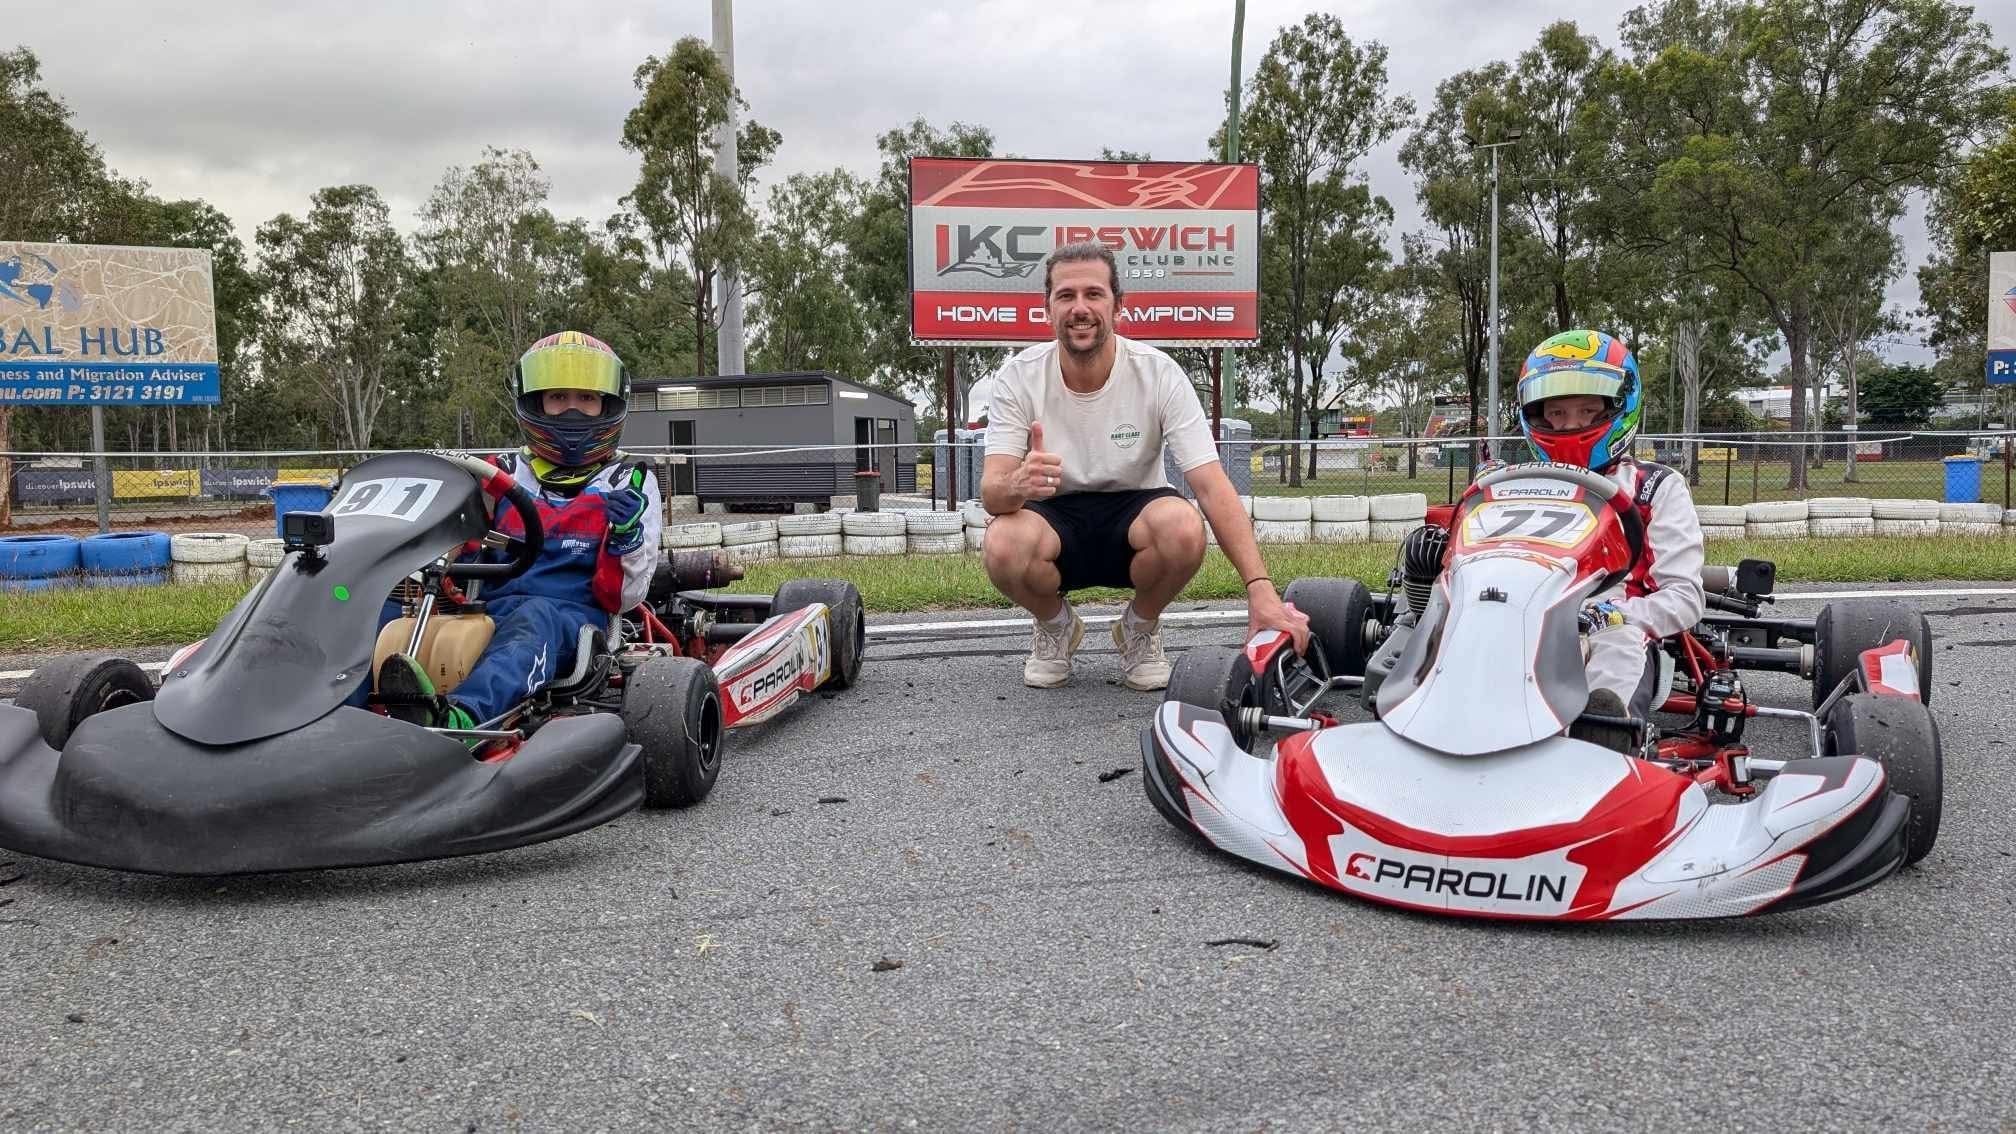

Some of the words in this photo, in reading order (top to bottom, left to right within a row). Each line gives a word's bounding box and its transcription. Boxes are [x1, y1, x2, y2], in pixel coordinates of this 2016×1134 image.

[1056, 224, 1235, 251] IPSWICH
[1127, 255, 1185, 266] CLUB
[1198, 255, 1235, 266] INC
[1125, 269, 1166, 279] 1958
[937, 306, 1017, 322] HOME
[1028, 307, 1048, 323] O
[1120, 306, 1235, 322] AMPIONS
[80, 326, 167, 356] HUB
[36, 369, 64, 381] and
[70, 367, 144, 384] Migration
[150, 369, 206, 381] Adviser
[1993, 360, 2009, 375] P:
[0, 385, 62, 400] u.com
[68, 385, 85, 400] P:
[90, 385, 135, 400] 3121
[141, 385, 185, 400] 3191
[337, 483, 428, 516] 91
[1508, 488, 1570, 497] PAROLIN
[1485, 509, 1577, 538] 77
[753, 648, 805, 700] PAROLIN
[1374, 858, 1568, 902] PAROLIN
